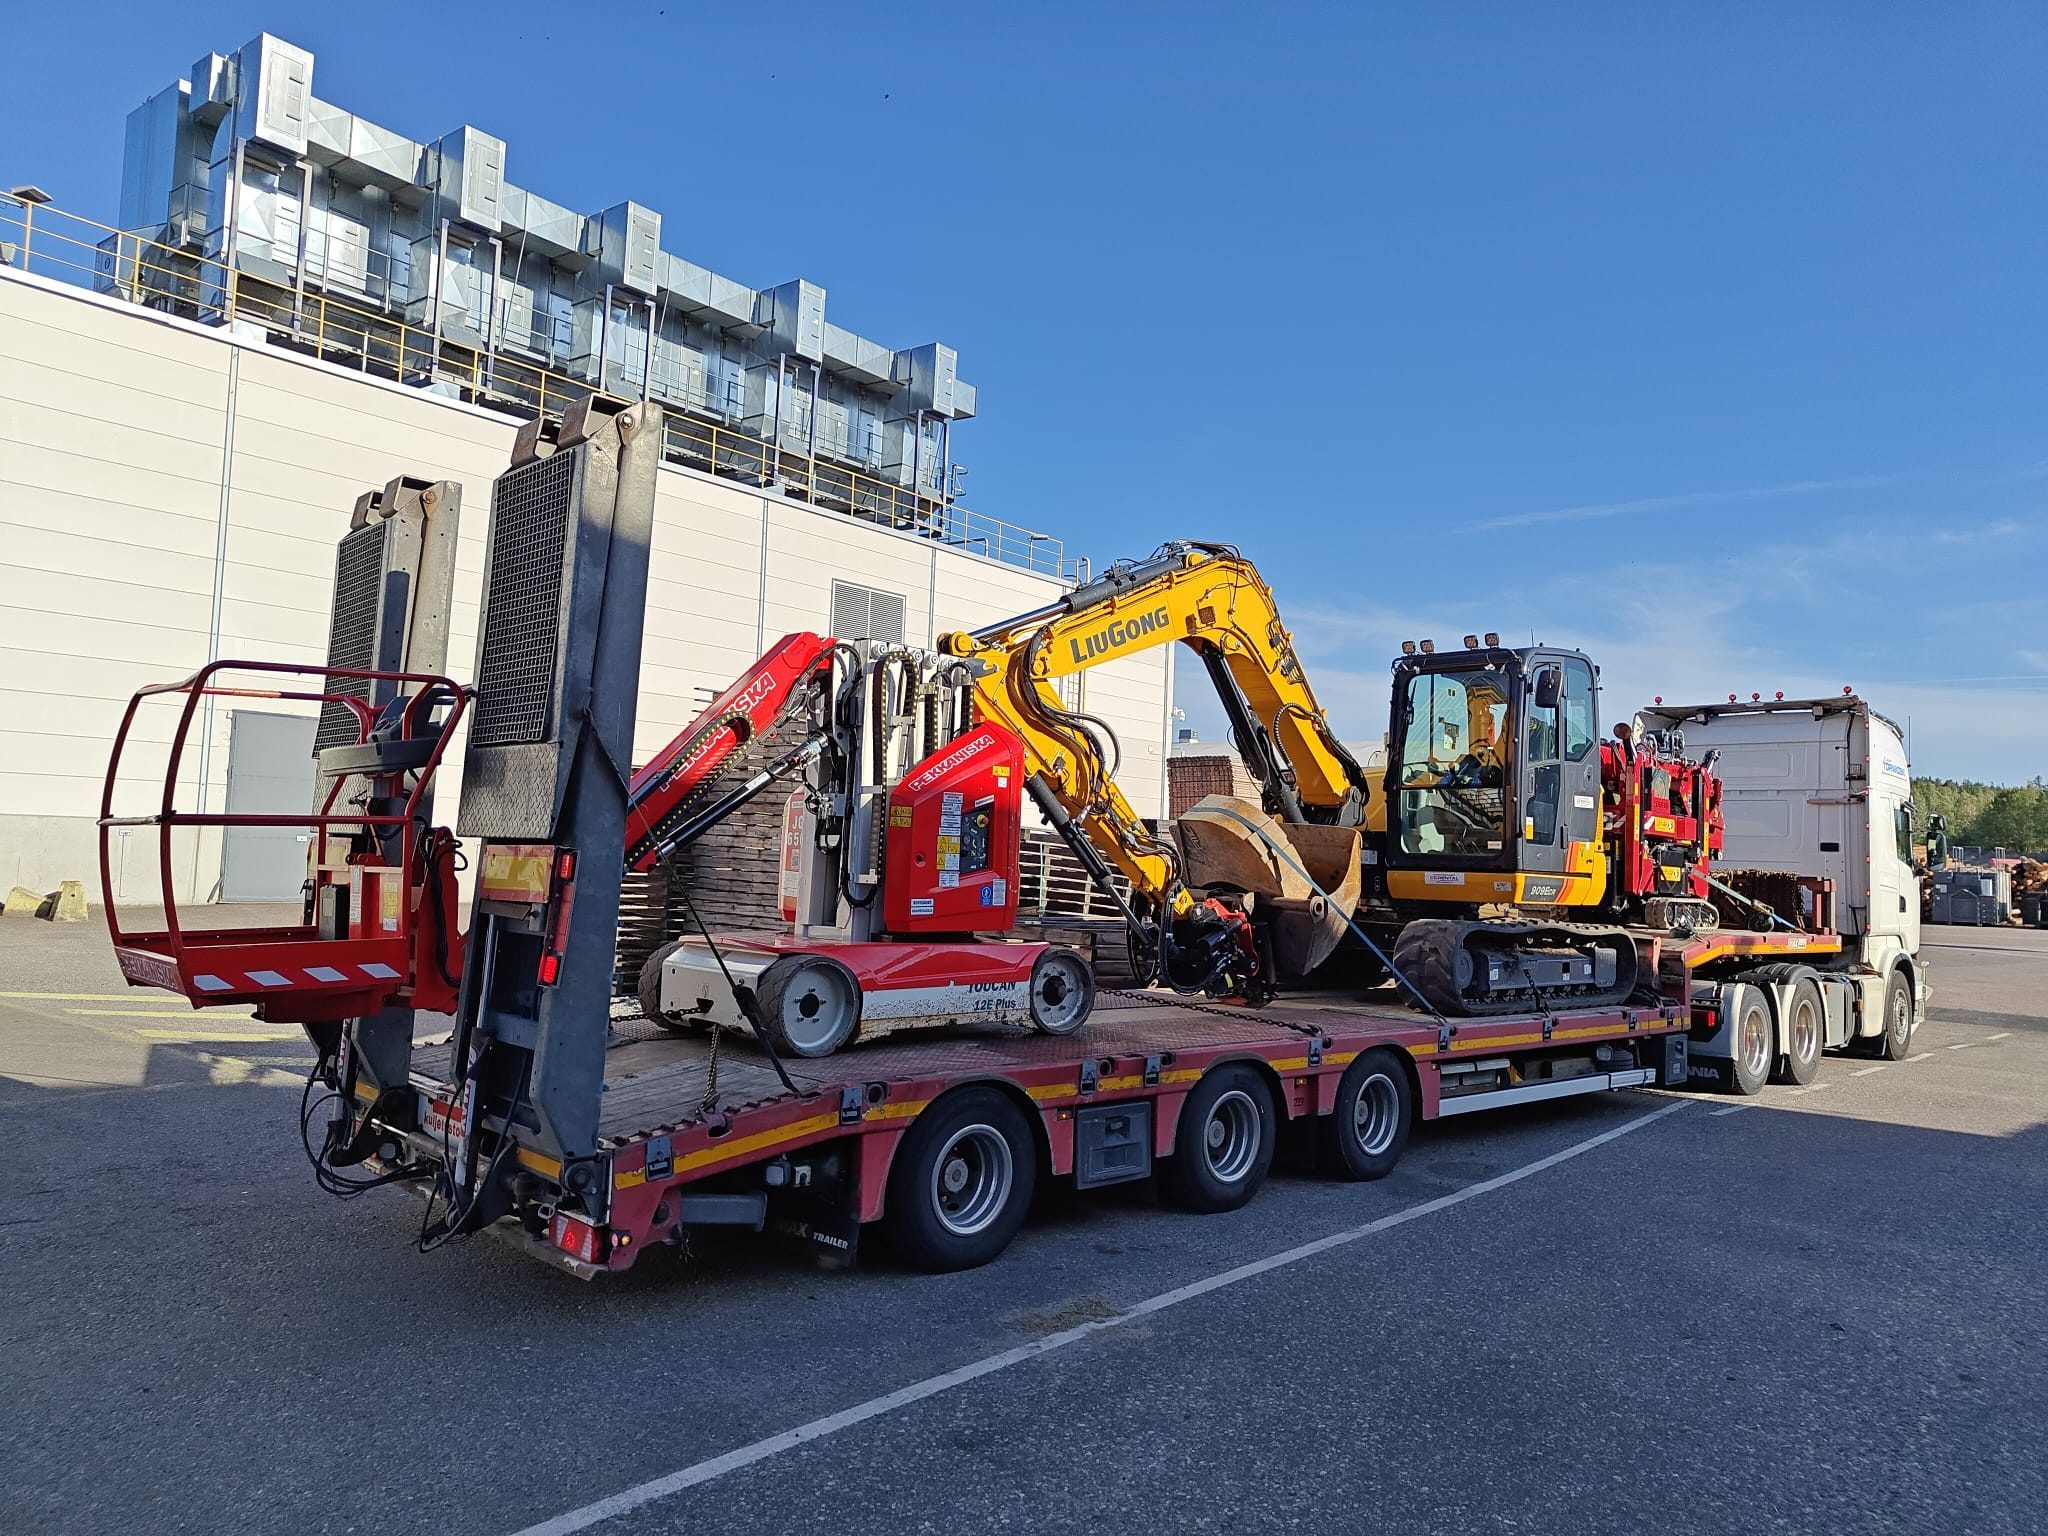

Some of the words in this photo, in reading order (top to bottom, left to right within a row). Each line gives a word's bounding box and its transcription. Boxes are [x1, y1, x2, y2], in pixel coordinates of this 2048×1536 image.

[908, 734, 996, 792] PEKKANISKA
[974, 999, 994, 1011] 12E
[995, 998, 1017, 1010] Plus
[813, 1231, 849, 1250] TRAILER
